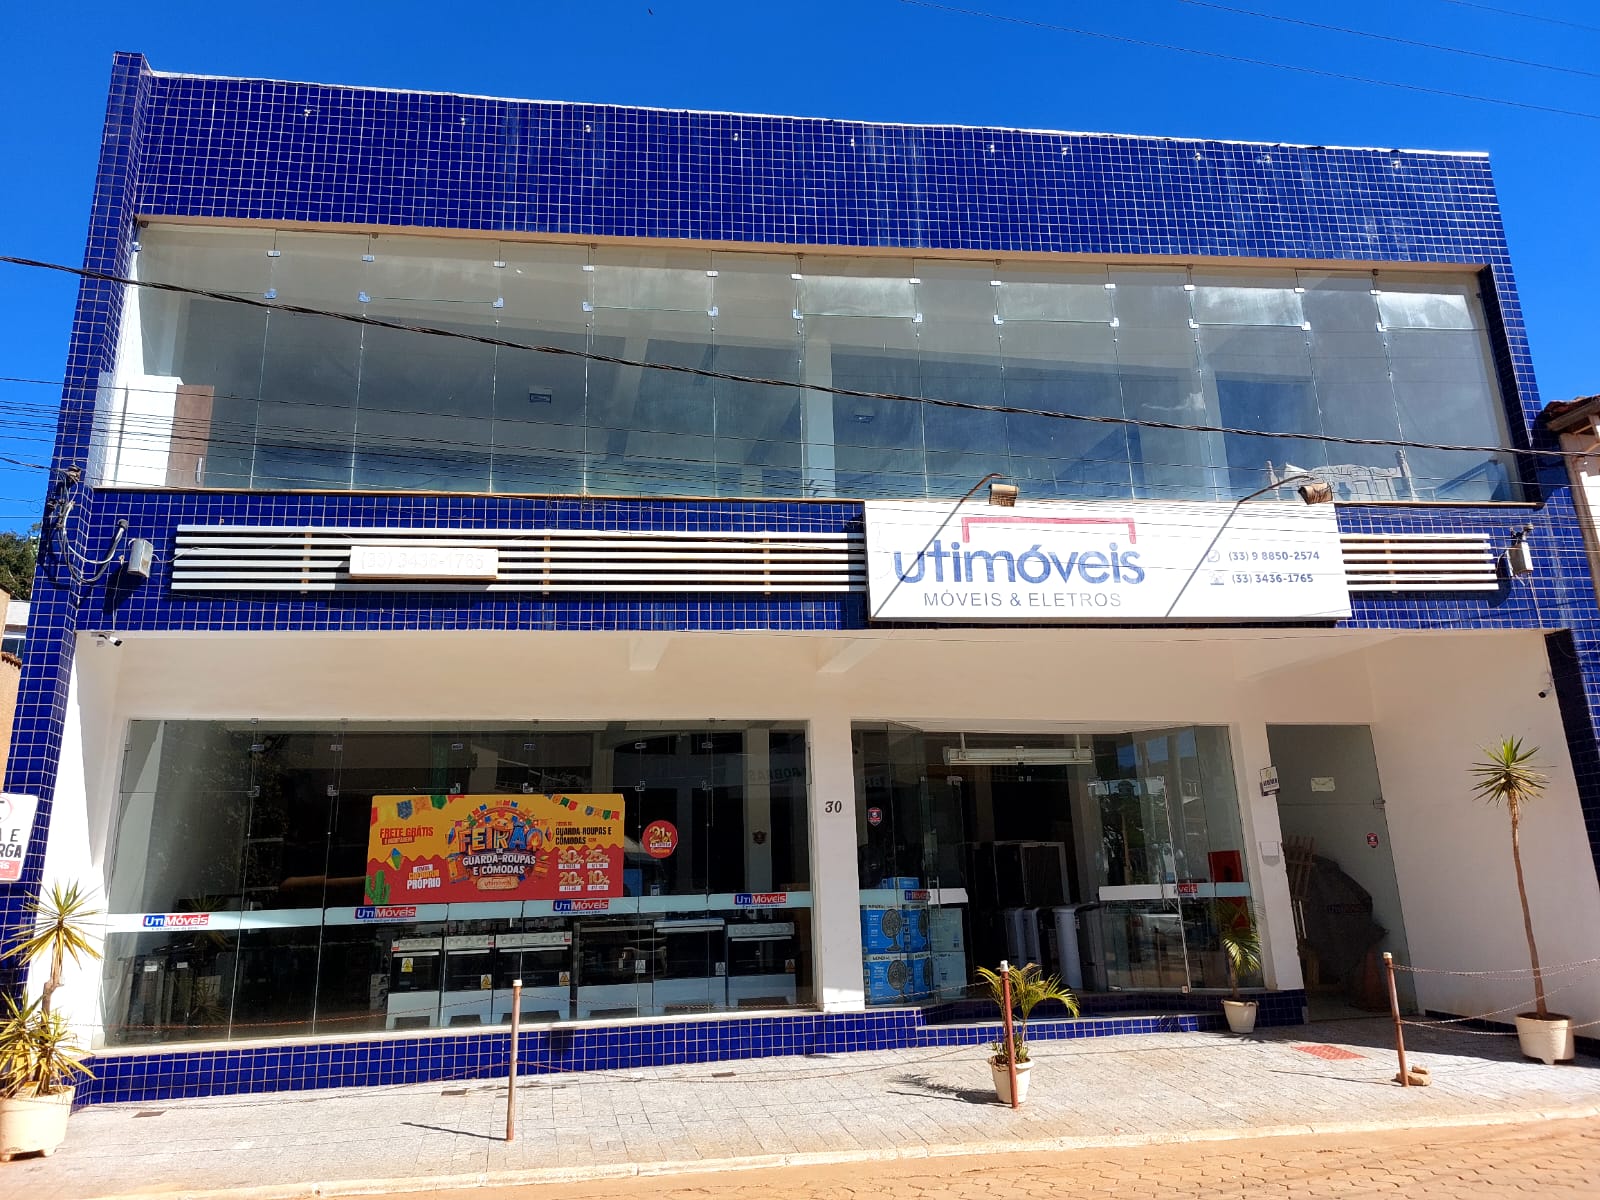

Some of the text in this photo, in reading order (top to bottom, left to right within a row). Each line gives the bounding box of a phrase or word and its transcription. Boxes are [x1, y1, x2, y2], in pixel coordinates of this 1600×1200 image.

[893, 540, 1145, 585] utimóveis
[1228, 551, 1320, 562] (33) 9 8850-2574
[1232, 574, 1314, 584] (33) 3436-1765
[923, 589, 1122, 608] MÓVEIS & ELETROS
[824, 800, 843, 813] 30
[10, 829, 20, 842] E
[380, 825, 434, 838] FRETE GRÁTIS
[458, 821, 543, 855] FEIRÃO
[462, 853, 536, 866] GUARDA-ROUPAS
[473, 864, 526, 876] E CÔMODAS
[406, 877, 441, 890] PRÓPRIO
